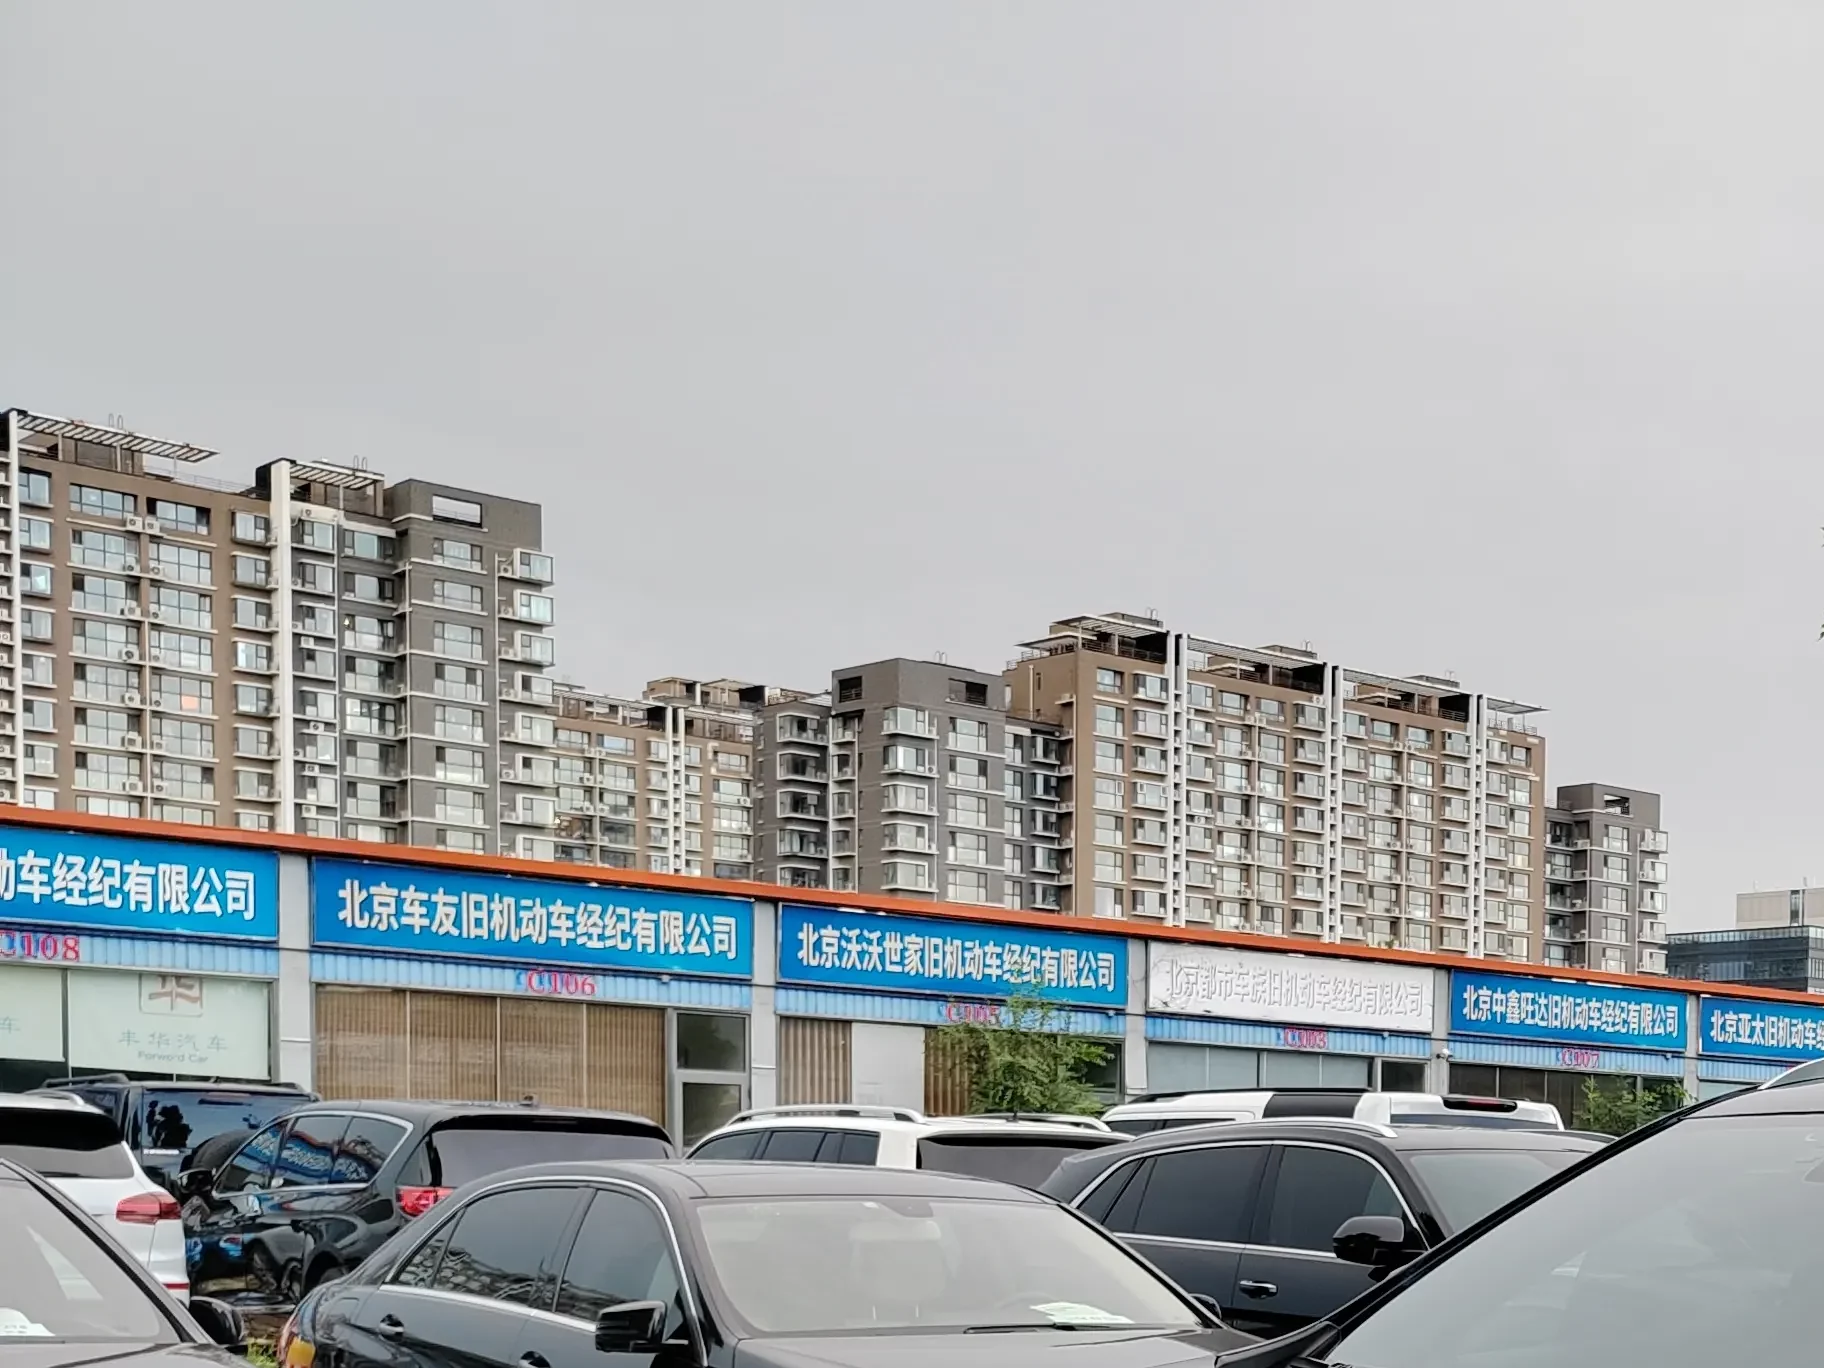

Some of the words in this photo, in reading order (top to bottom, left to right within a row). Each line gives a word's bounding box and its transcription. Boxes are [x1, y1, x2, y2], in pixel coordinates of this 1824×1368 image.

[337, 879, 738, 960] 北京车友旧机动车经纪有限公司
[797, 922, 1116, 992] 北京沃沃世家旧机动车经纪有限公司
[1462, 984, 1679, 1038] 北京中鑫旺达旧机动车经纪有限公司
